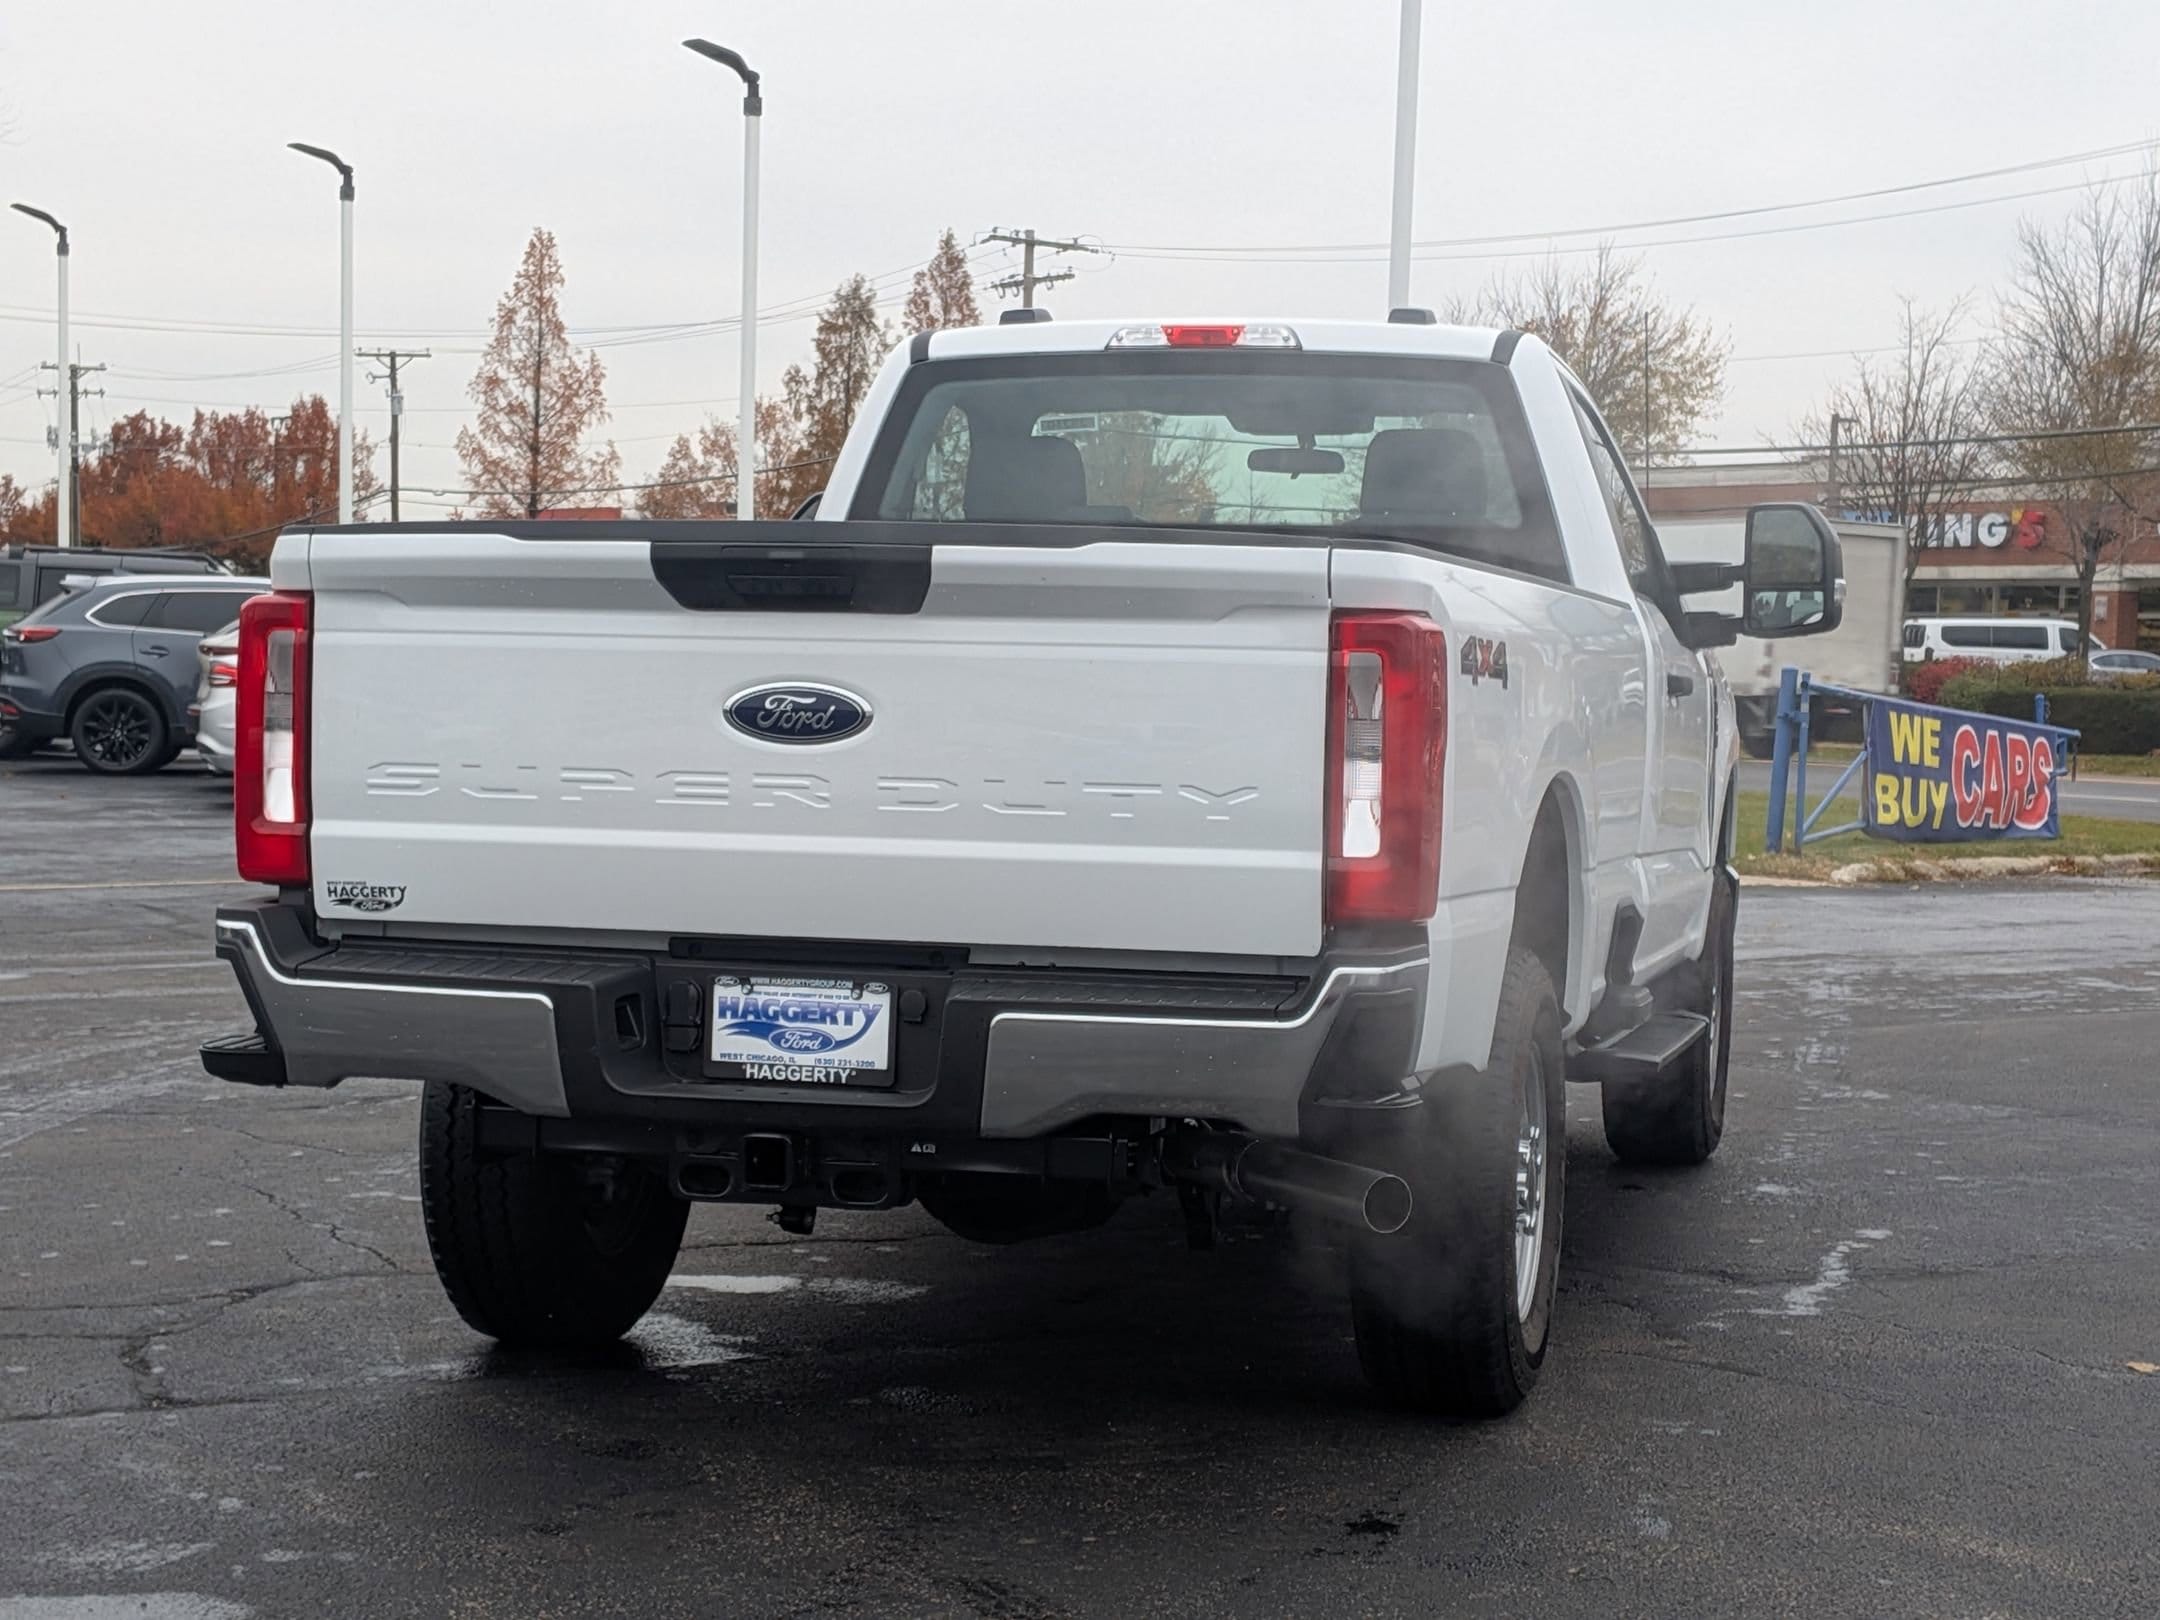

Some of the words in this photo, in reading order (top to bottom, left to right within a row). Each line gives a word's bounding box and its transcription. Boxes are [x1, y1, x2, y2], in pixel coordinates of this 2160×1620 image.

[757, 694, 836, 733] Ford
[1888, 711, 1942, 768] WE
[367, 763, 830, 808] SUPER
[877, 776, 1259, 820] DUTY
[1951, 724, 2053, 830] CARS
[1874, 773, 1949, 830] BUY
[327, 886, 407, 898] HAGGERTY
[718, 996, 883, 1028] HAGGERTY
[720, 1052, 743, 1061] WEST
[780, 1031, 822, 1050] Ford
[745, 1063, 850, 1084] HAGGERTY
